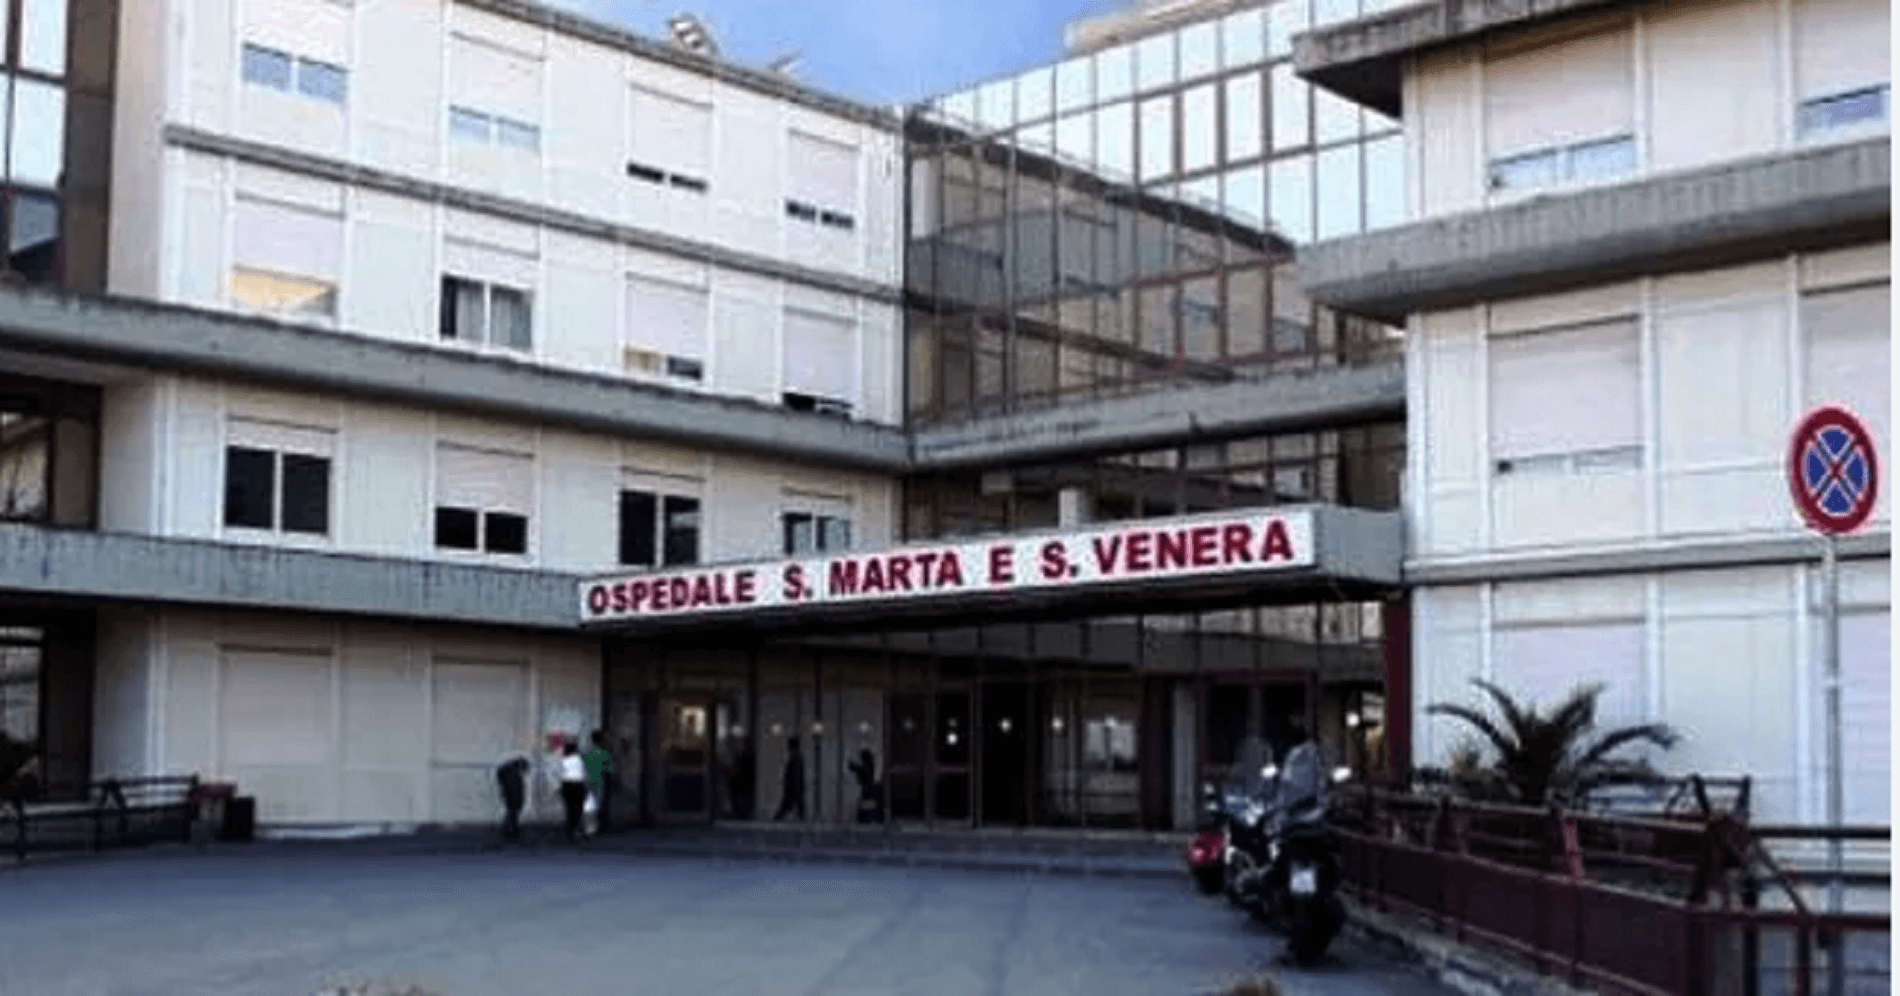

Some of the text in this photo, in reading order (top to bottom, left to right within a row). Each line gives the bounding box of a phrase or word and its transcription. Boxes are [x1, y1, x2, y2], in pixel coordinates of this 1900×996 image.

[588, 519, 1295, 613] OSPEDALE S. MARTA E S. VENERA
